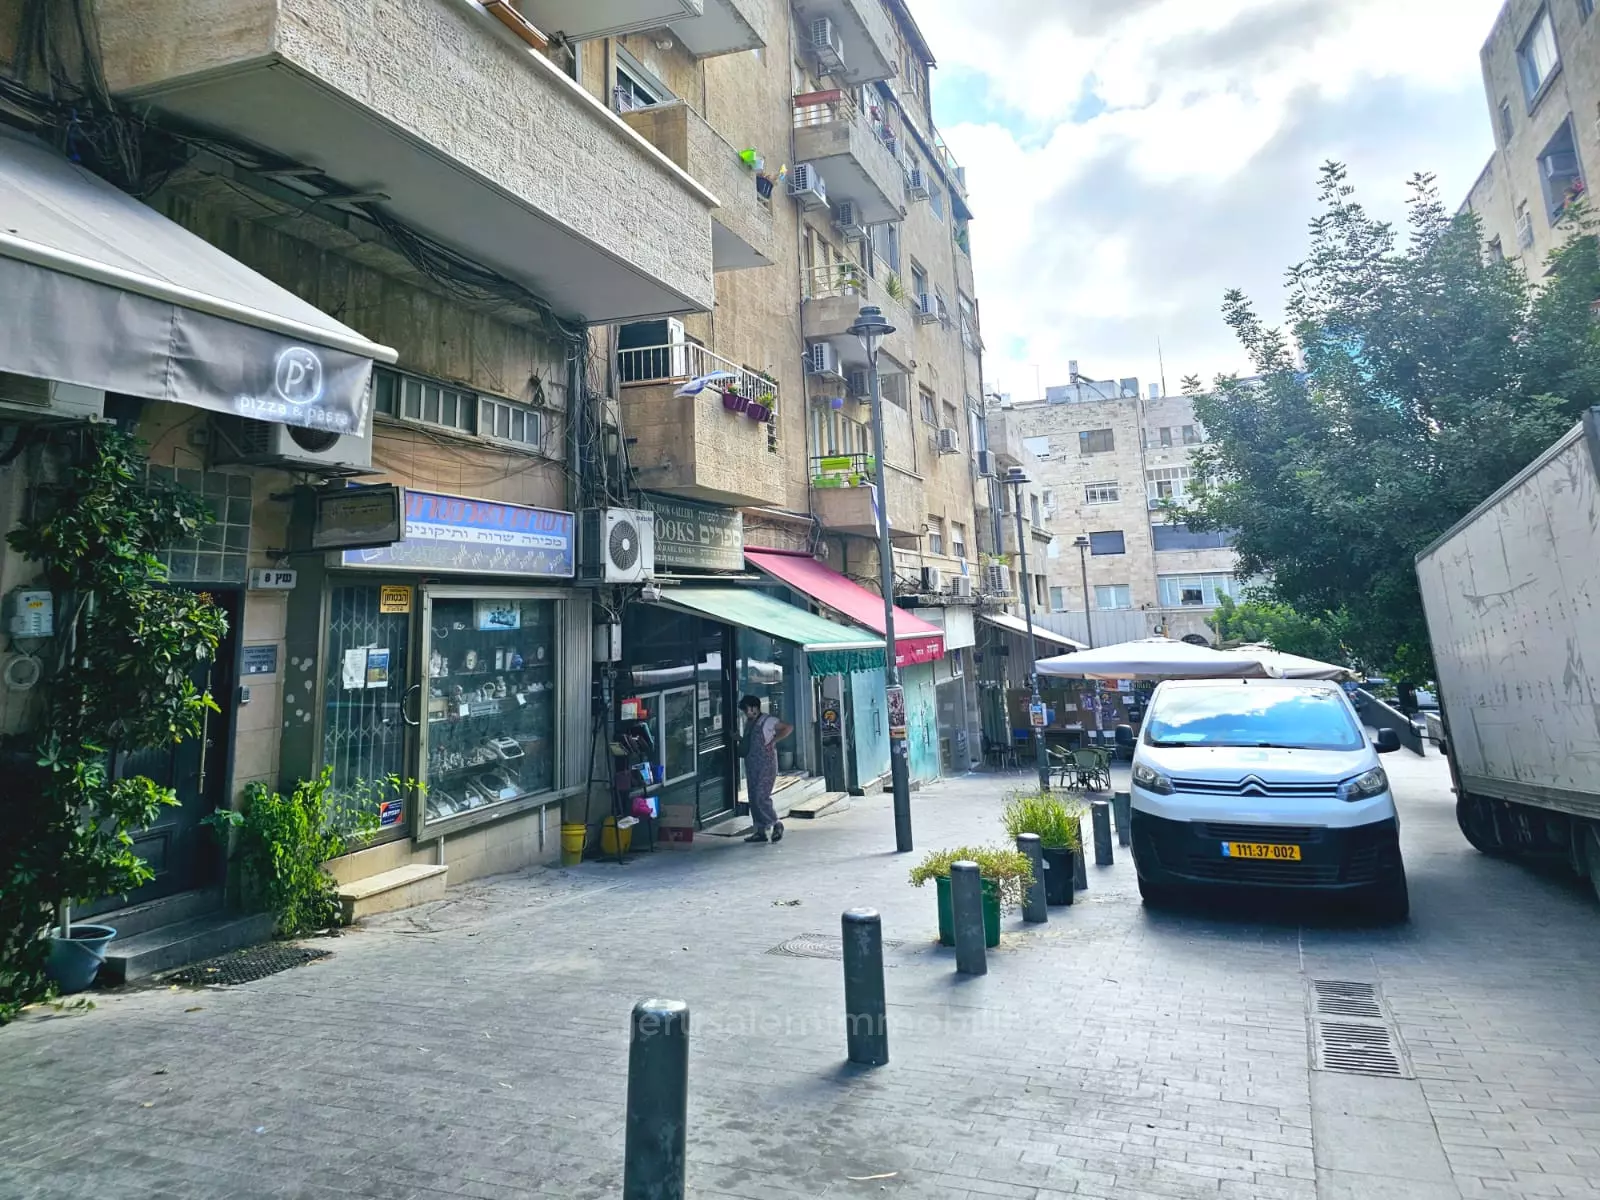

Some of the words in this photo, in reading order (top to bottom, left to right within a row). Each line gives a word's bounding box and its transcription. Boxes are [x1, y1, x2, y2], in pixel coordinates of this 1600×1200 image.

[239, 395, 287, 413] pizza
[292, 406, 303, 417] &
[306, 405, 349, 426] pasta
[476, 531, 515, 543] שרות
[521, 534, 563, 547] מכירה
[654, 518, 695, 542] OOKS
[699, 523, 742, 548] ספרים
